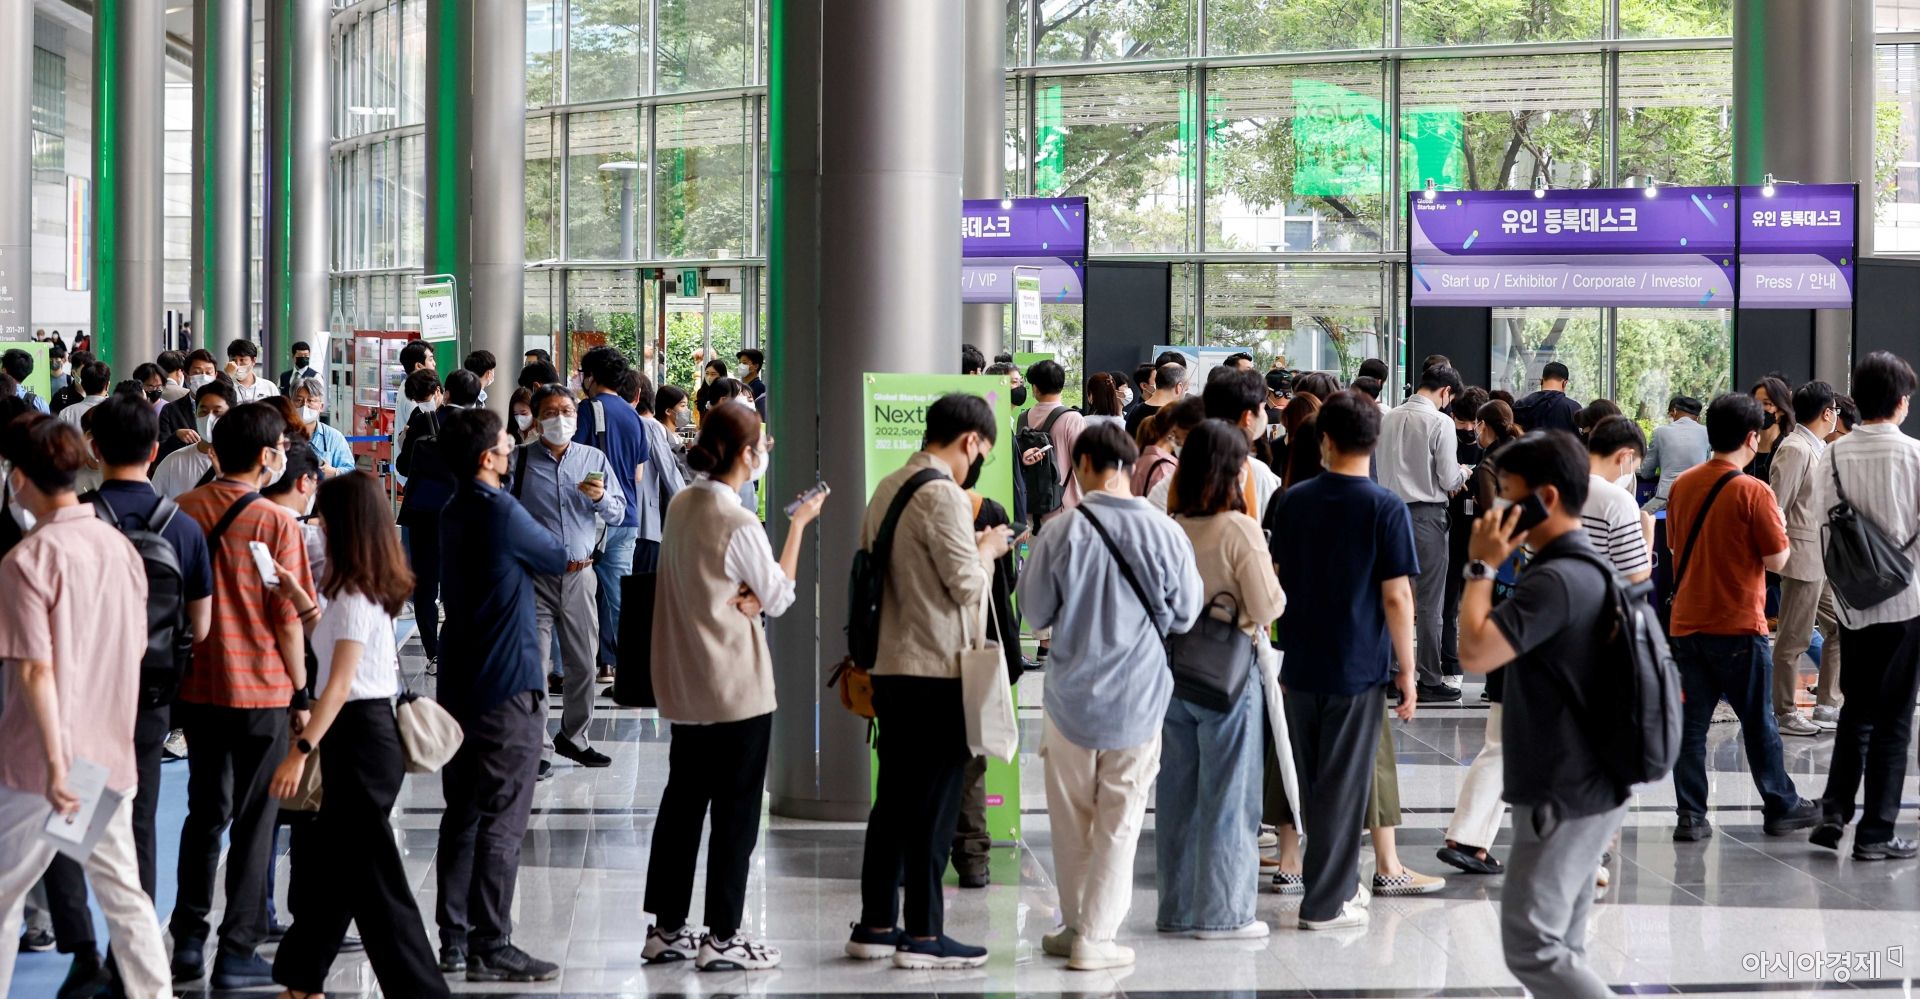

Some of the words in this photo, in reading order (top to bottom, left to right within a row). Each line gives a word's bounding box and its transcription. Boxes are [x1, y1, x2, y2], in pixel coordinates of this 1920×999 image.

[1501, 209, 1538, 234] 유인
[1544, 207, 1638, 234] 등록데스크
[1752, 210, 1777, 227] 유인
[1780, 210, 1841, 227] 등록데스크
[978, 273, 997, 287] VIP
[1441, 273, 1470, 288] Start
[1474, 277, 1490, 291] up
[1504, 274, 1558, 288] Exhibitor
[1572, 273, 1636, 290] Corporate
[1651, 274, 1703, 288] Investor
[1756, 274, 1793, 289] Press
[1809, 273, 1836, 290] 안내
[426, 312, 448, 320] Speaker
